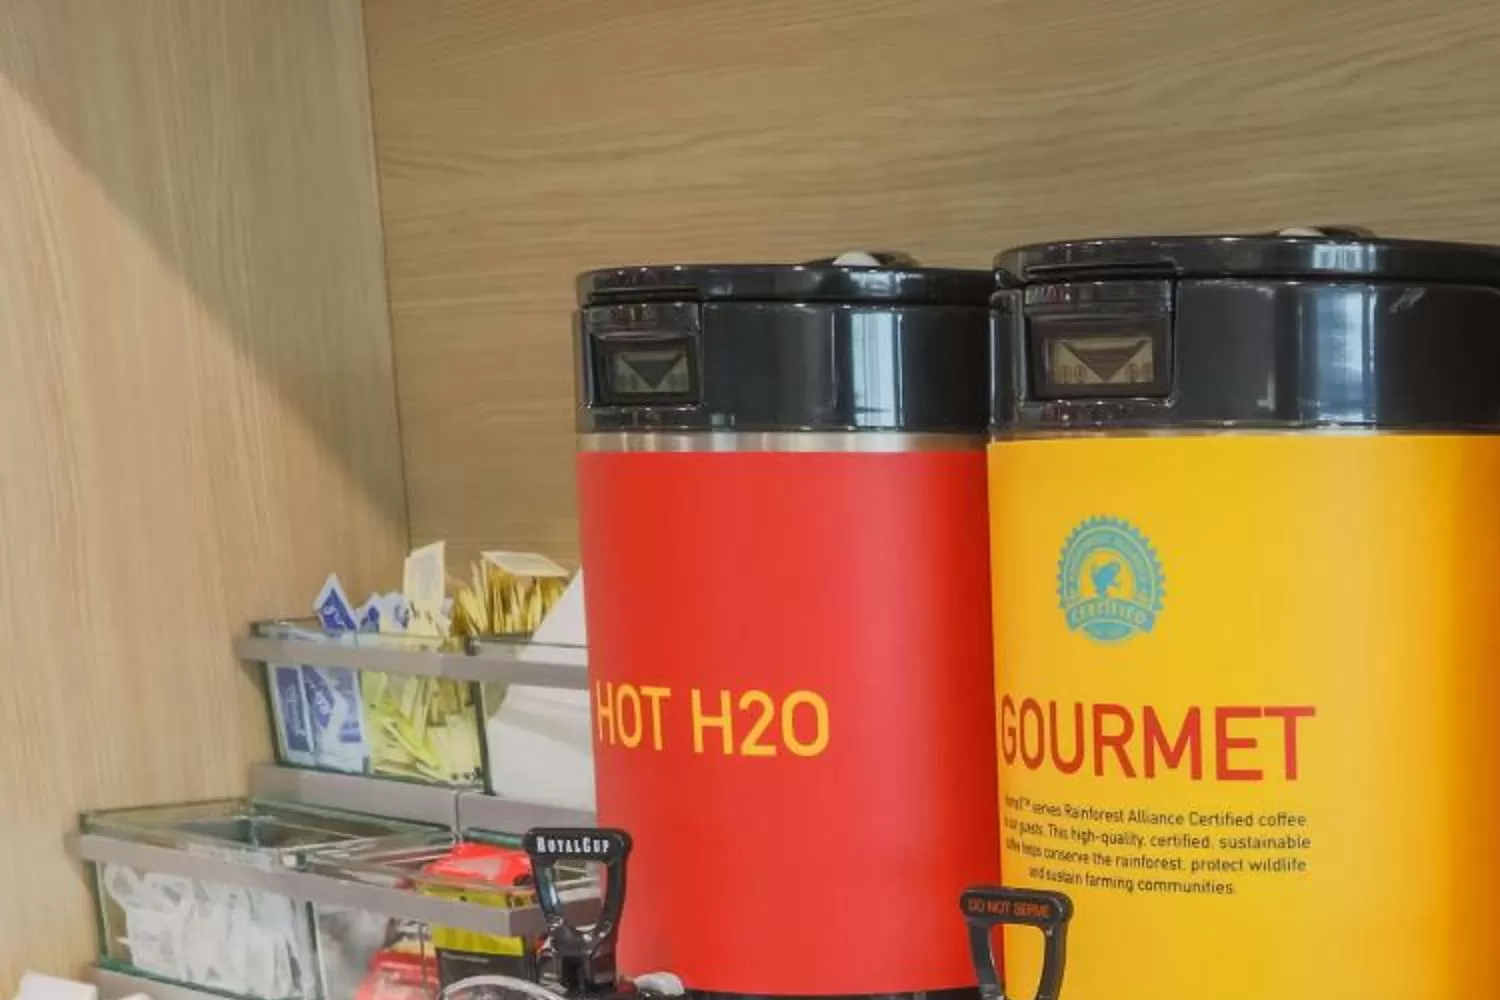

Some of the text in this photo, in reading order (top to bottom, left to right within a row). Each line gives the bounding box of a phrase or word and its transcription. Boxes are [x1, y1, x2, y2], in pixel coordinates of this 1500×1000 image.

[596, 680, 830, 757] HOT H2O
[1001, 694, 1316, 781] GOURMET
[1064, 804, 1124, 823] Rainforest
[1128, 808, 1184, 824] Alliance
[1189, 811, 1253, 826] Certified
[1259, 811, 1307, 826] coffee
[1219, 835, 1311, 849] sustainable
[1044, 847, 1089, 864] conserve
[1092, 851, 1112, 866] the
[1191, 858, 1243, 874] protect
[1249, 857, 1307, 872] wildlife
[1086, 872, 1133, 893] farming
